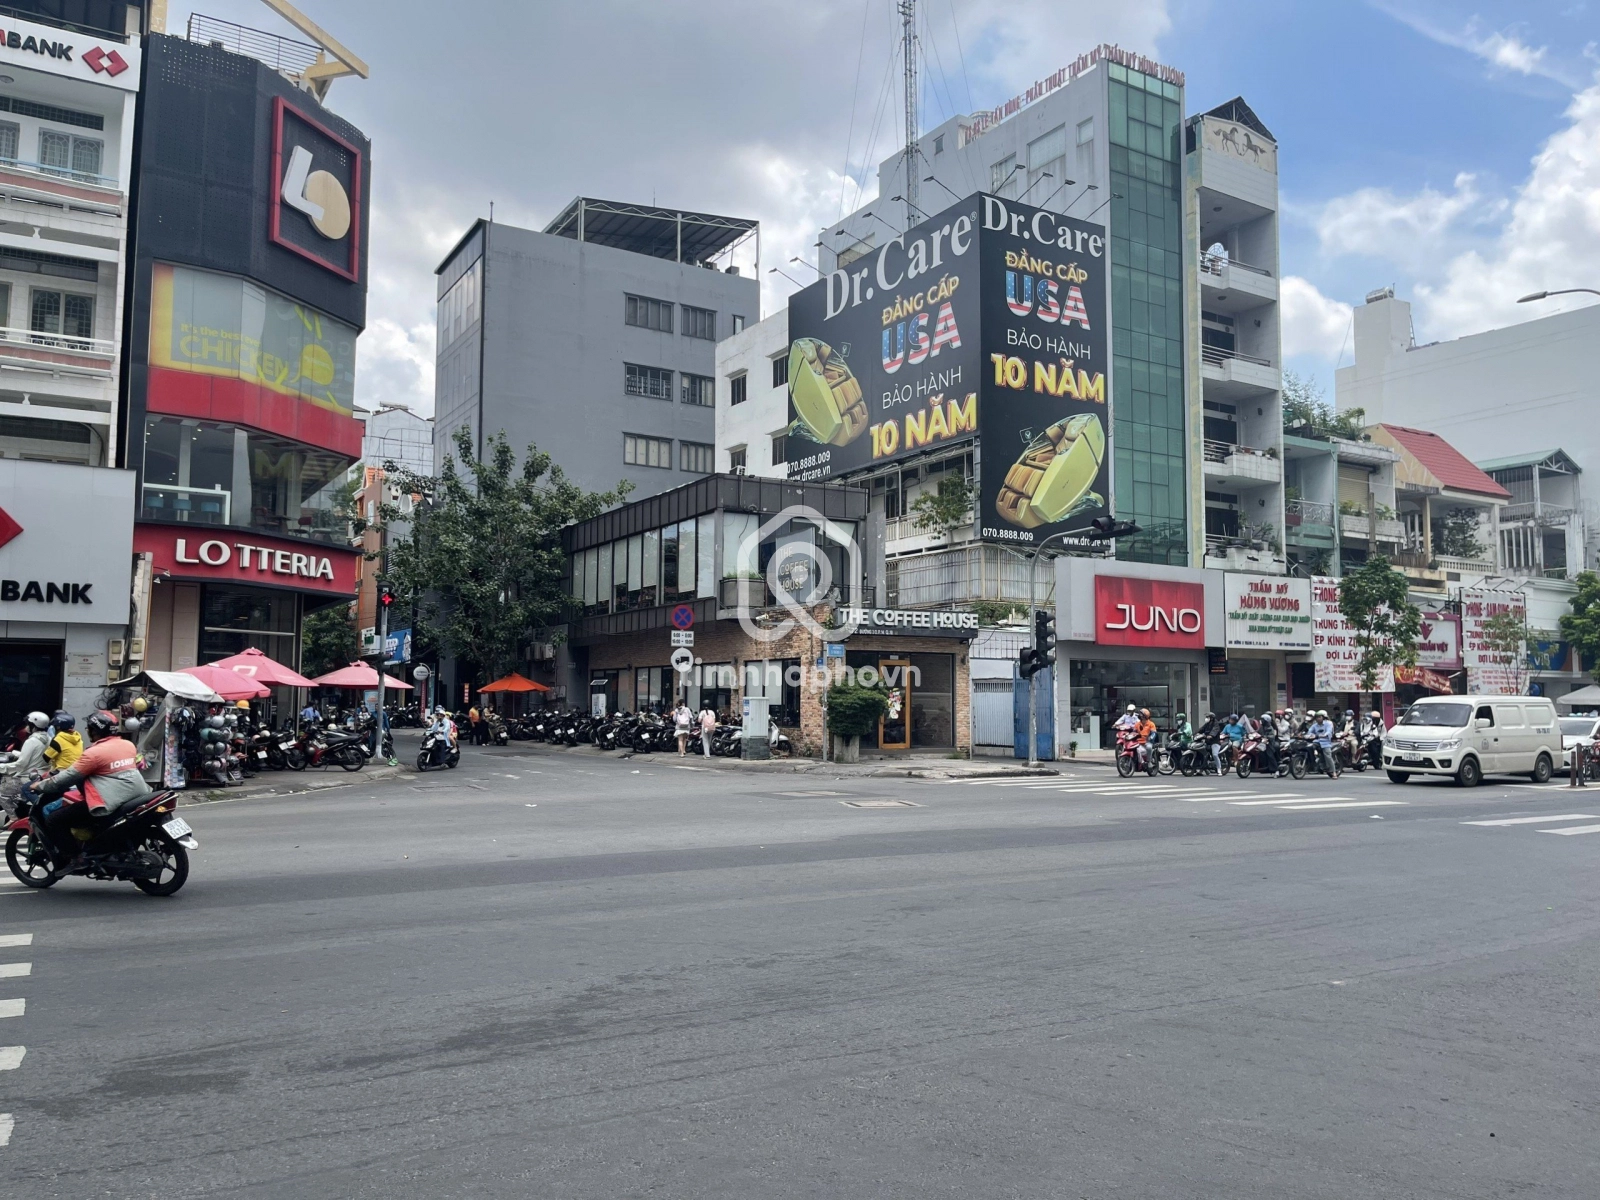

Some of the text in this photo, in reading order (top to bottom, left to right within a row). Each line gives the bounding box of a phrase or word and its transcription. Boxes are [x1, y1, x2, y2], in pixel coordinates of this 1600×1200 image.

[1005, 248, 1088, 284] ĐẲNG CẤP
[882, 272, 960, 326] ĐẲNG CẤP
[1005, 270, 1091, 331] USA
[882, 301, 962, 374] USA
[1007, 327, 1091, 360] BẢO HÀNH
[883, 365, 962, 409] BẢO HÀNH
[991, 353, 1105, 403] 10 NĂM
[870, 393, 977, 459] 10 NĂM
[787, 450, 830, 474] 070.8888.009
[982, 527, 1034, 541] 070.8888.009
[1063, 535, 1111, 547] www.drcrevn
[175, 538, 335, 580] LOTTERIA
[1, 580, 93, 604] BANK
[1276, 582, 1289, 595] MỸ
[840, 608, 979, 629] THE COFFEE HOUSE
[1105, 603, 1201, 633] JUNO
